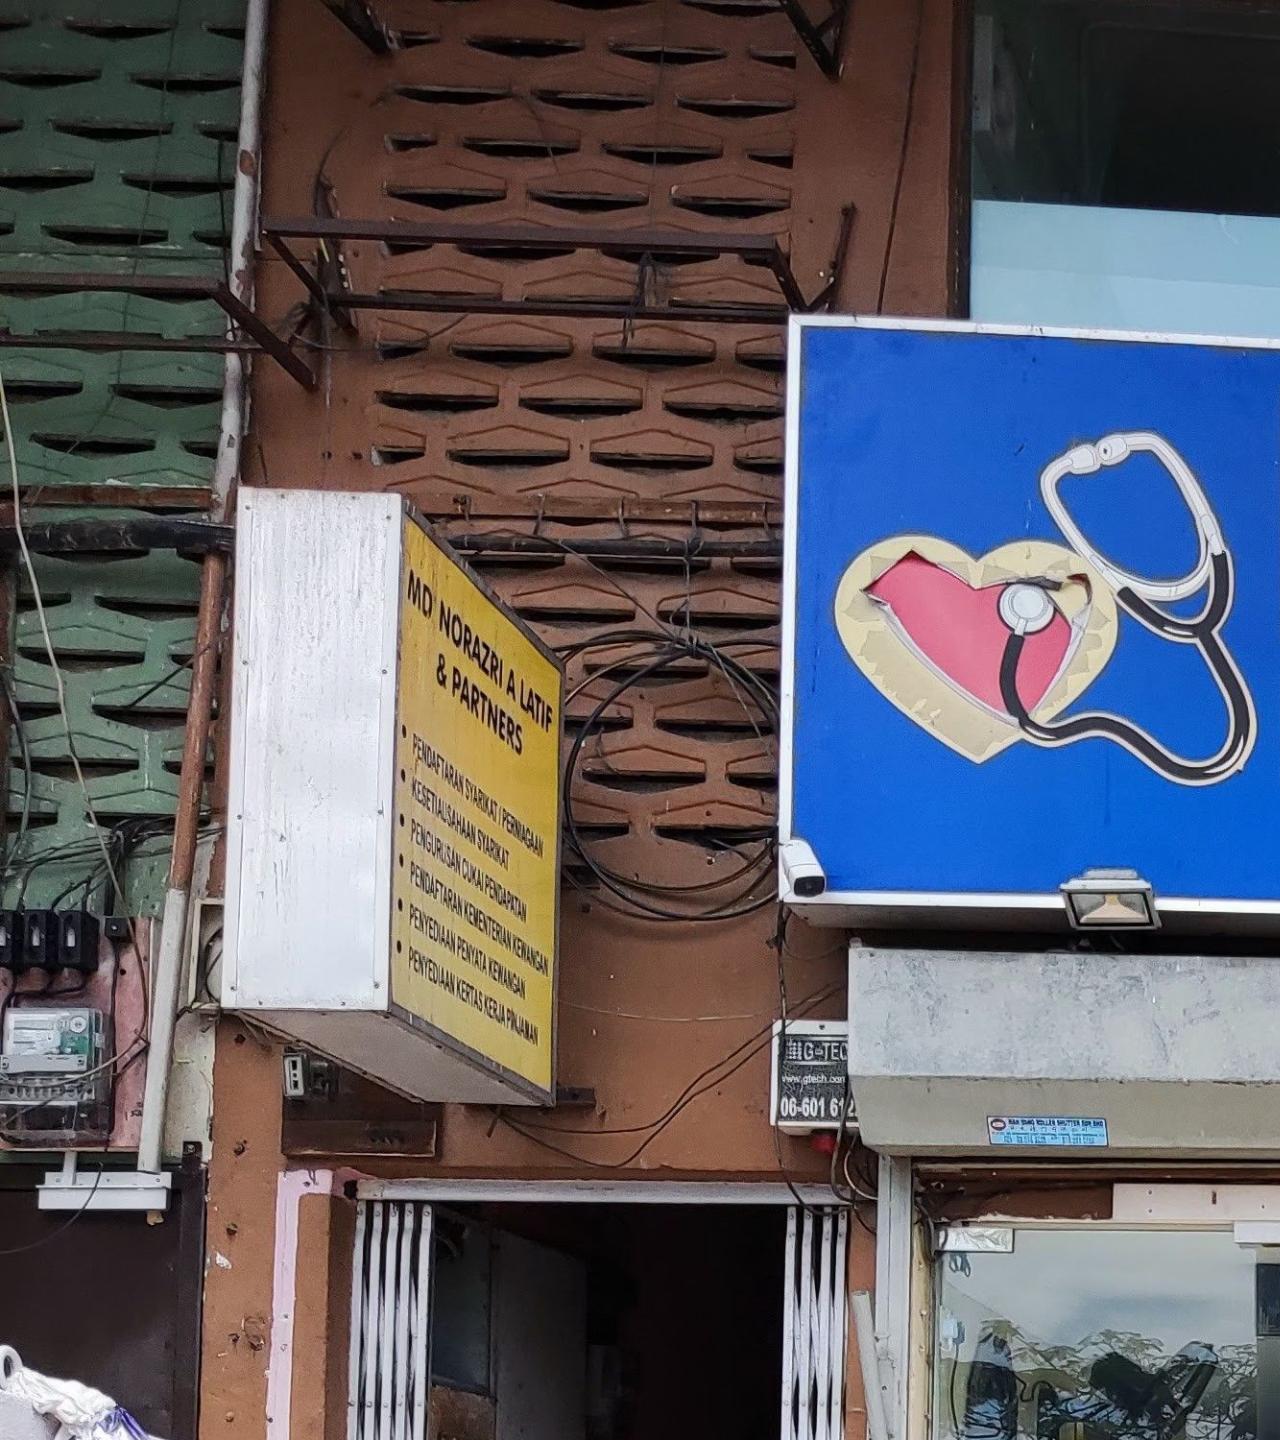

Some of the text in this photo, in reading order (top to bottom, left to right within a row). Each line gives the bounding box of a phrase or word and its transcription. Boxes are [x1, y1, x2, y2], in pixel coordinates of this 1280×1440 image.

[408, 569, 553, 732] MD NORAZRI A LATIF
[452, 666, 522, 755] PARTNERS
[412, 733, 464, 795] PENDAFTARAN
[411, 818, 484, 892] PENGURUSAN CUKAI
[477, 829, 510, 871] SYARIKAT
[410, 861, 462, 918] PENDAFTARAN
[409, 903, 455, 955] PENYEDIAAN
[456, 936, 487, 974] PENYATA
[409, 945, 483, 1013] PENYEDIAAN KERTAS
